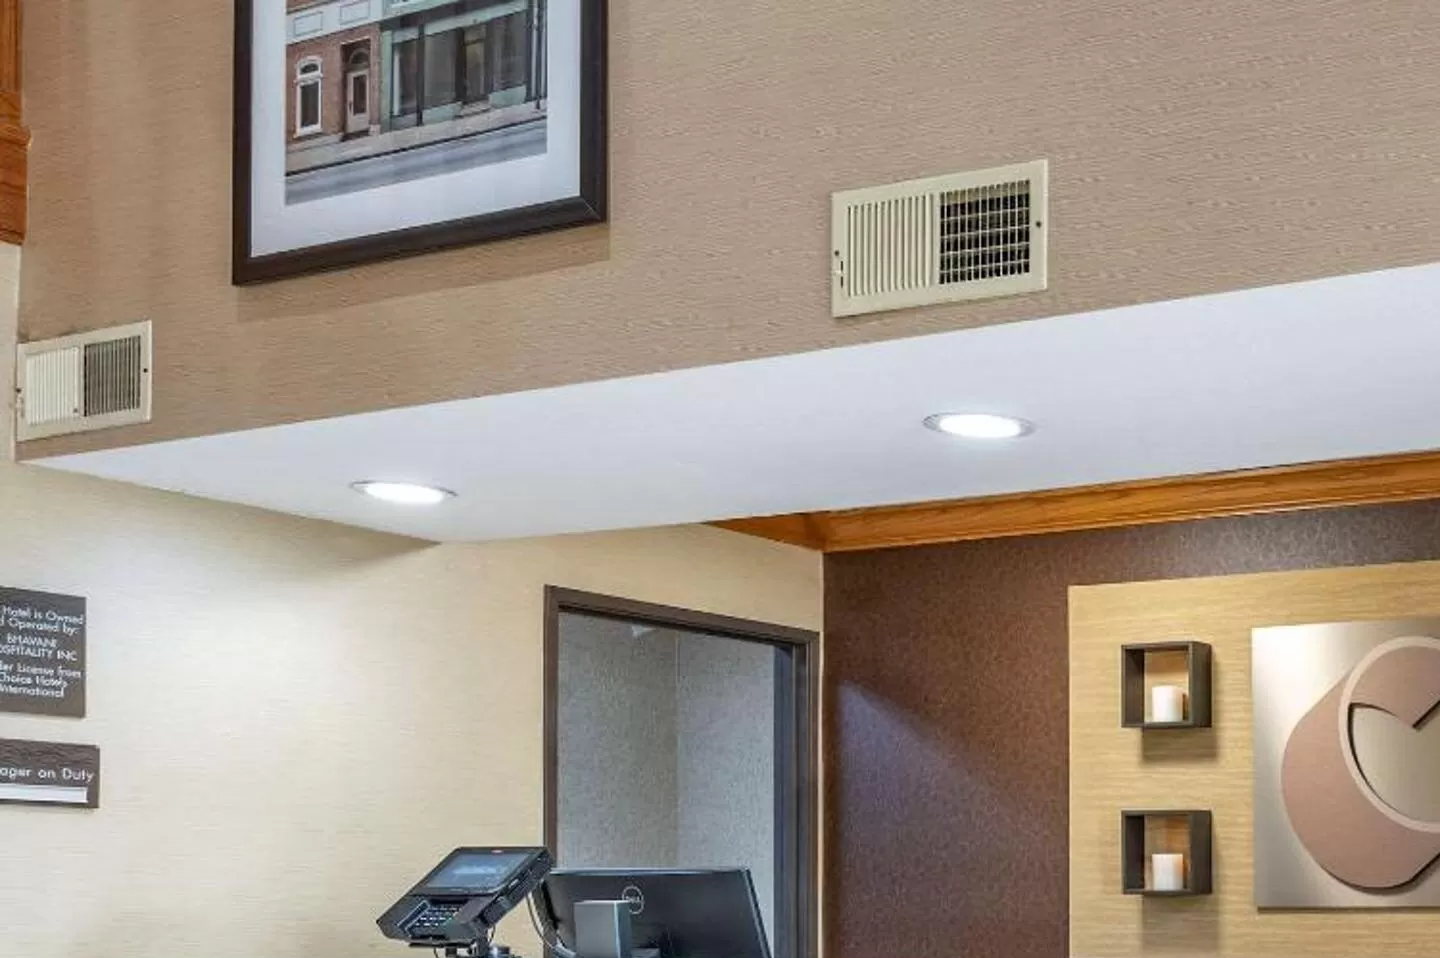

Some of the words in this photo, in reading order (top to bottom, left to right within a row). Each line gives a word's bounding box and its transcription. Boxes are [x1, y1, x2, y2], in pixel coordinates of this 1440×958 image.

[3, 604, 31, 619] Hotel
[34, 608, 43, 619] is
[45, 610, 83, 625] Owned
[8, 617, 59, 632] Operated
[56, 649, 77, 661] INC
[16, 663, 55, 676] License
[57, 665, 81, 679] from
[38, 768, 56, 779] on
[62, 767, 94, 783] Duty
